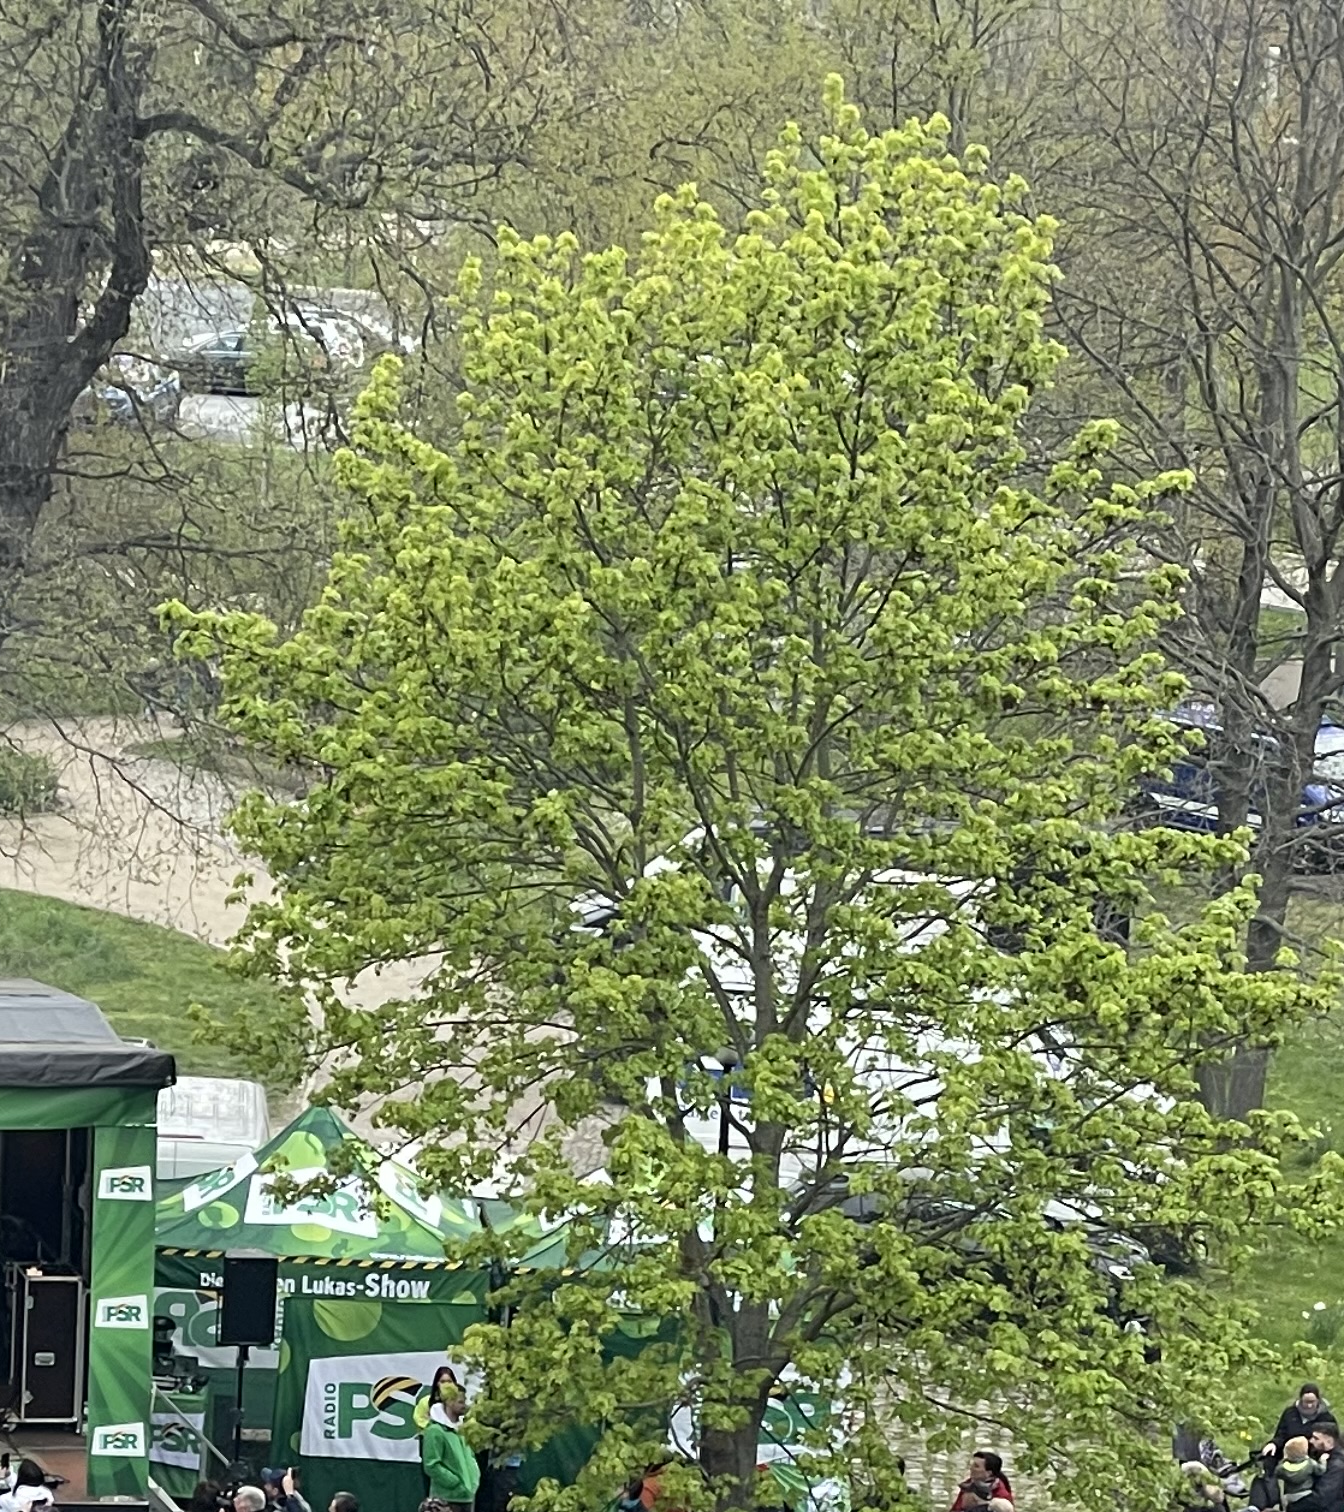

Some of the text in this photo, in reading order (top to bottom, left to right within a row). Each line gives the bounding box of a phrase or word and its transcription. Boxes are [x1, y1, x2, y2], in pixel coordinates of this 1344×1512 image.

[110, 1176, 145, 1193] PSR
[106, 1304, 142, 1322] PSR
[323, 1377, 432, 1440] RADIO PS
[103, 1432, 138, 1449] PSR
